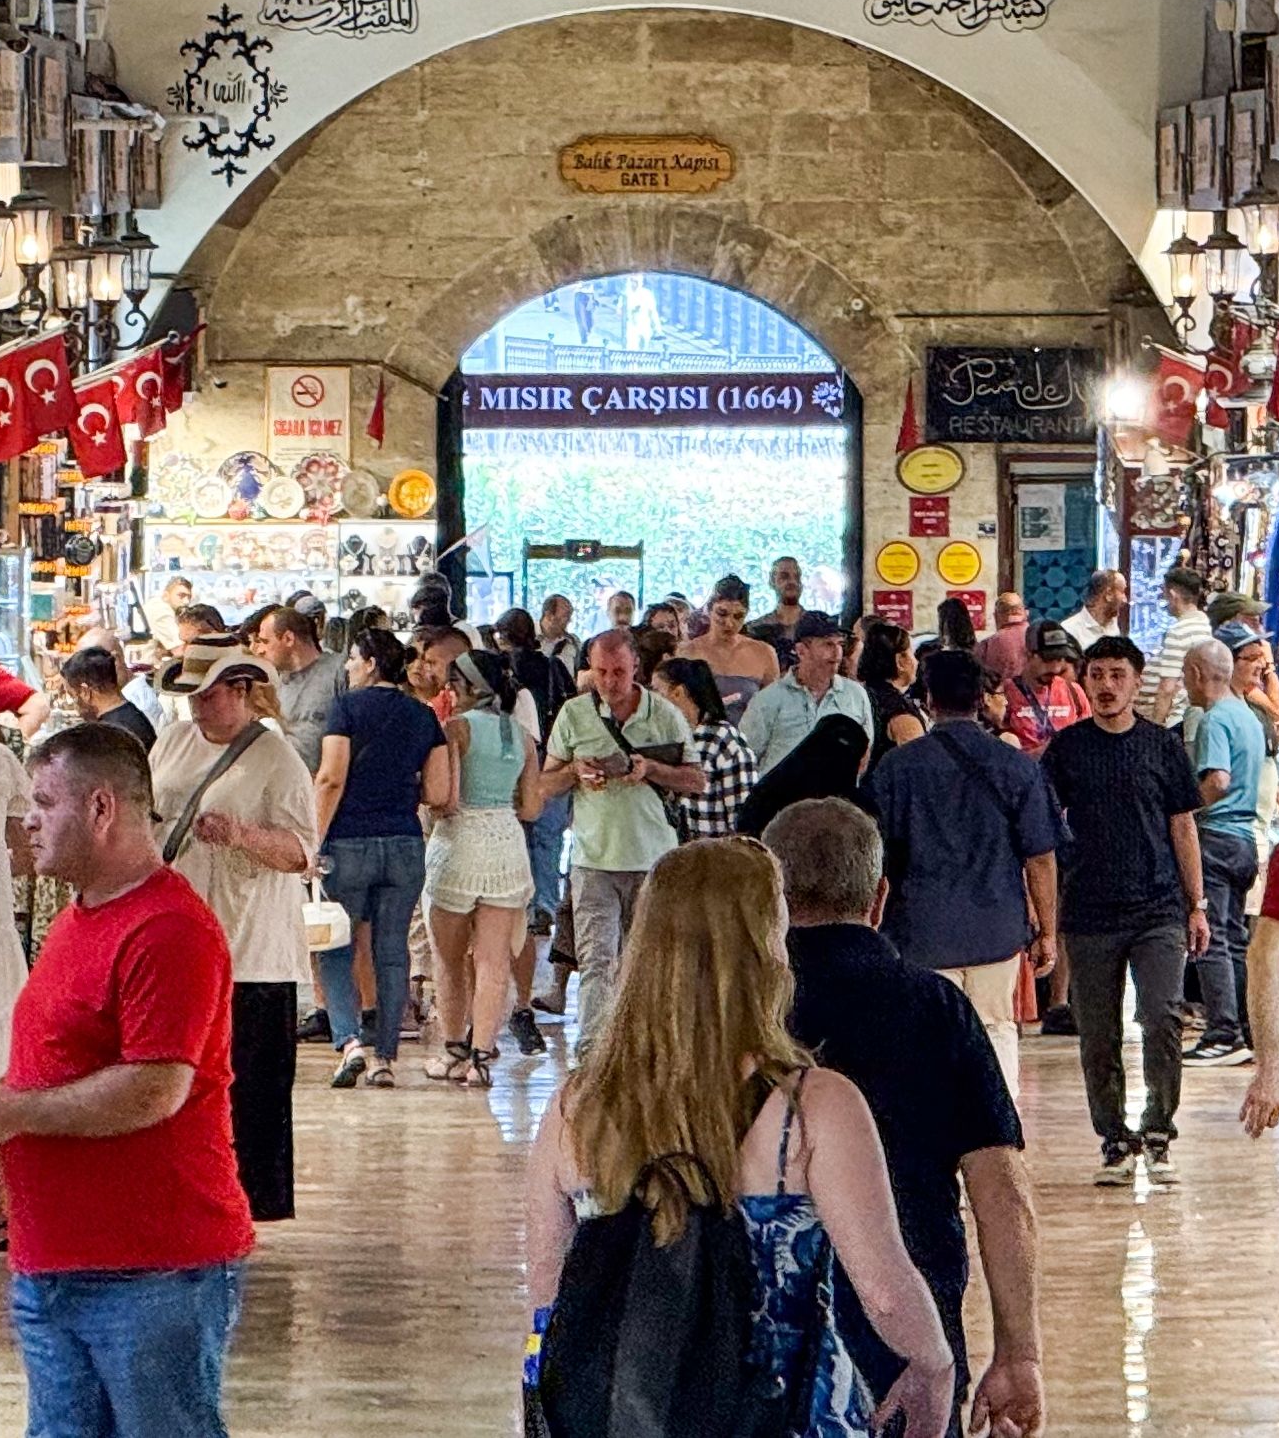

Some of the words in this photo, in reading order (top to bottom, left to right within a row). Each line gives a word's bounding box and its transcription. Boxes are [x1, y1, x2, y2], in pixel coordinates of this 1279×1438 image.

[621, 173, 659, 187] GATE
[479, 387, 571, 411] MISIR
[581, 387, 708, 416] ÇARŞISI
[717, 385, 804, 414] (1664)
